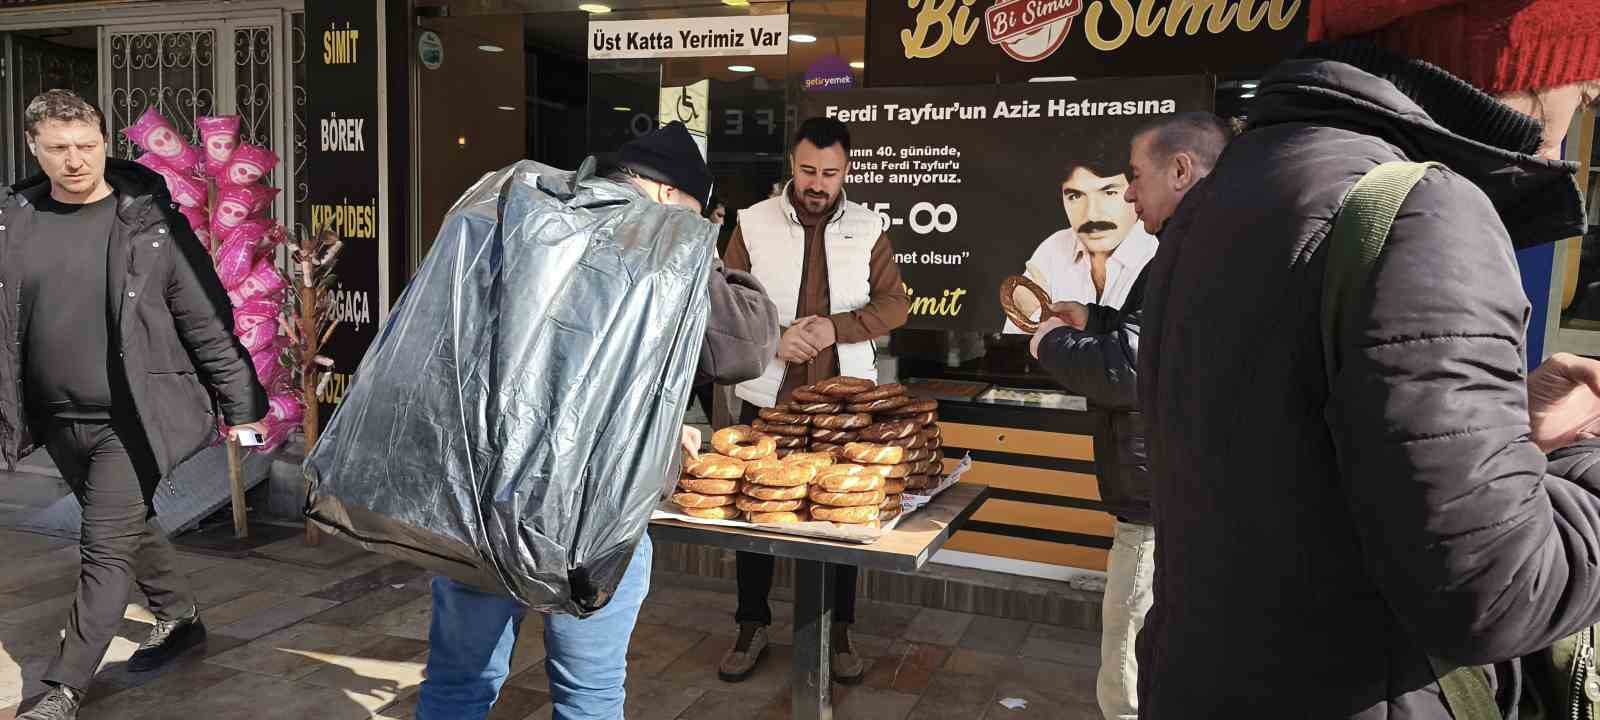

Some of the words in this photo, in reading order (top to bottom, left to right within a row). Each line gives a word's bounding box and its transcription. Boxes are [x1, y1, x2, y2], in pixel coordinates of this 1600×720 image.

[901, 0, 980, 59] Bi
[993, 11, 1017, 35] Bi
[324, 21, 359, 64] SİMİT
[593, 29, 621, 50] Üst
[627, 30, 673, 50] Katta
[679, 28, 744, 49] Yerimiz
[750, 27, 782, 46] Var
[805, 76, 850, 88] getiryemek
[826, 104, 877, 122] Ferdi
[883, 102, 986, 125] Tayfur’un
[992, 100, 1041, 118] Aziz
[1047, 98, 1176, 117] Hatırasına
[321, 112, 364, 152] BÖREK
[876, 146, 897, 157] 40.
[900, 145, 961, 159] gününde,
[852, 161, 878, 170] Usta
[881, 161, 910, 170] Ferdi
[913, 160, 960, 172] Tayfur’u
[888, 173, 961, 186] anıyoruz.
[336, 197, 375, 239] PİDESİ
[894, 251, 917, 264] net
[920, 251, 970, 265] olsun”
[326, 281, 370, 331] OĞAÇA
